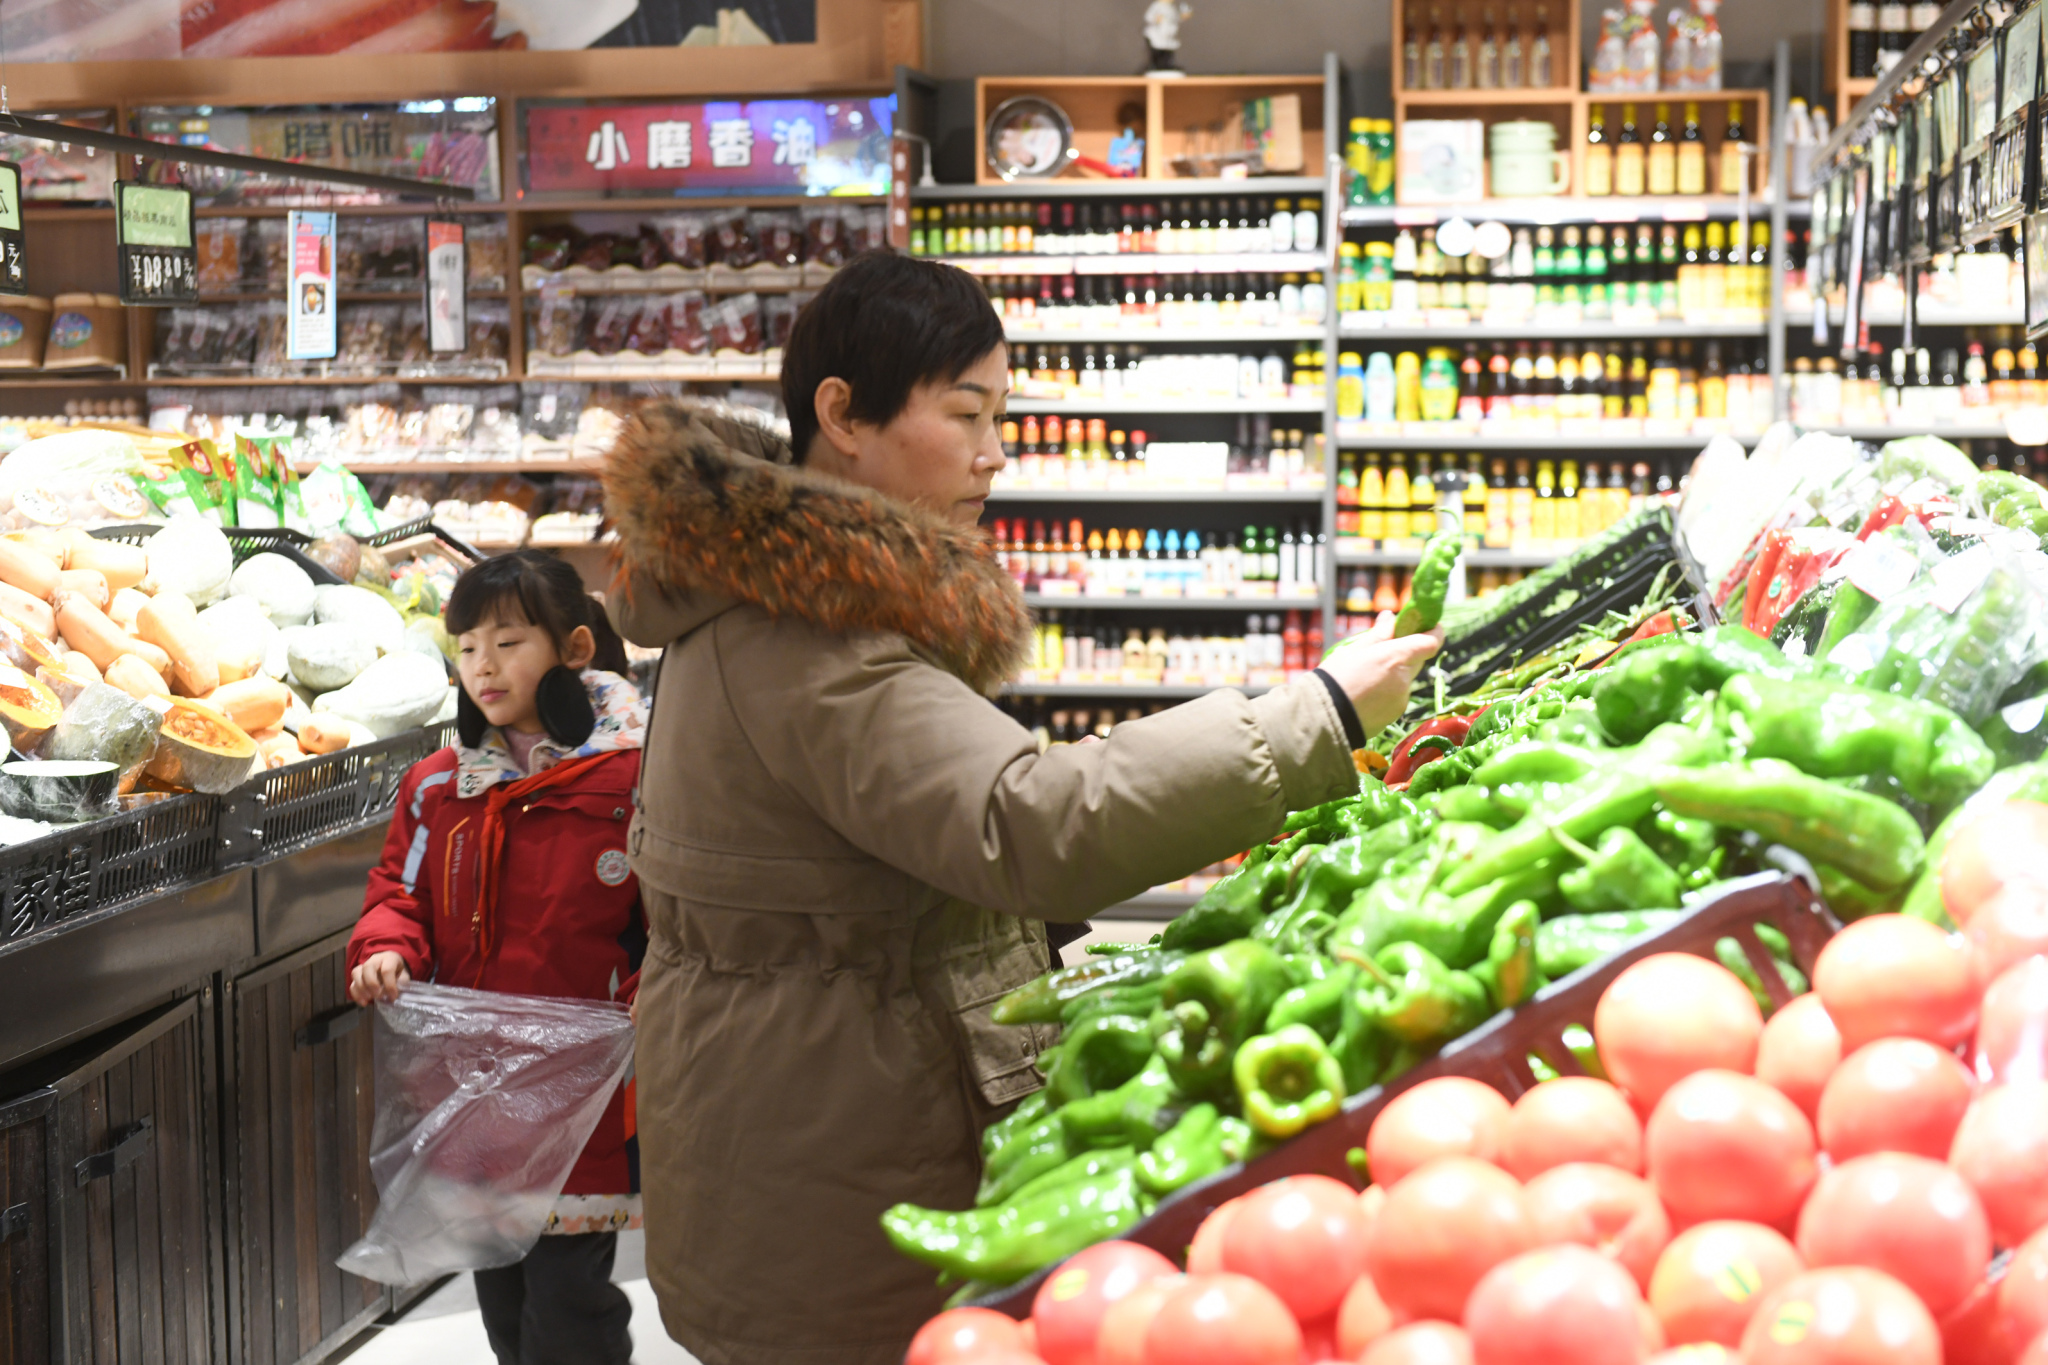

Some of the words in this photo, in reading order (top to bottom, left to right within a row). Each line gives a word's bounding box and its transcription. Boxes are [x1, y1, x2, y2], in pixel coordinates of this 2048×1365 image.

[586, 119, 817, 170] 小磨香油
[451, 833, 465, 875] SPORTS
[0, 846, 92, 937] 家福
